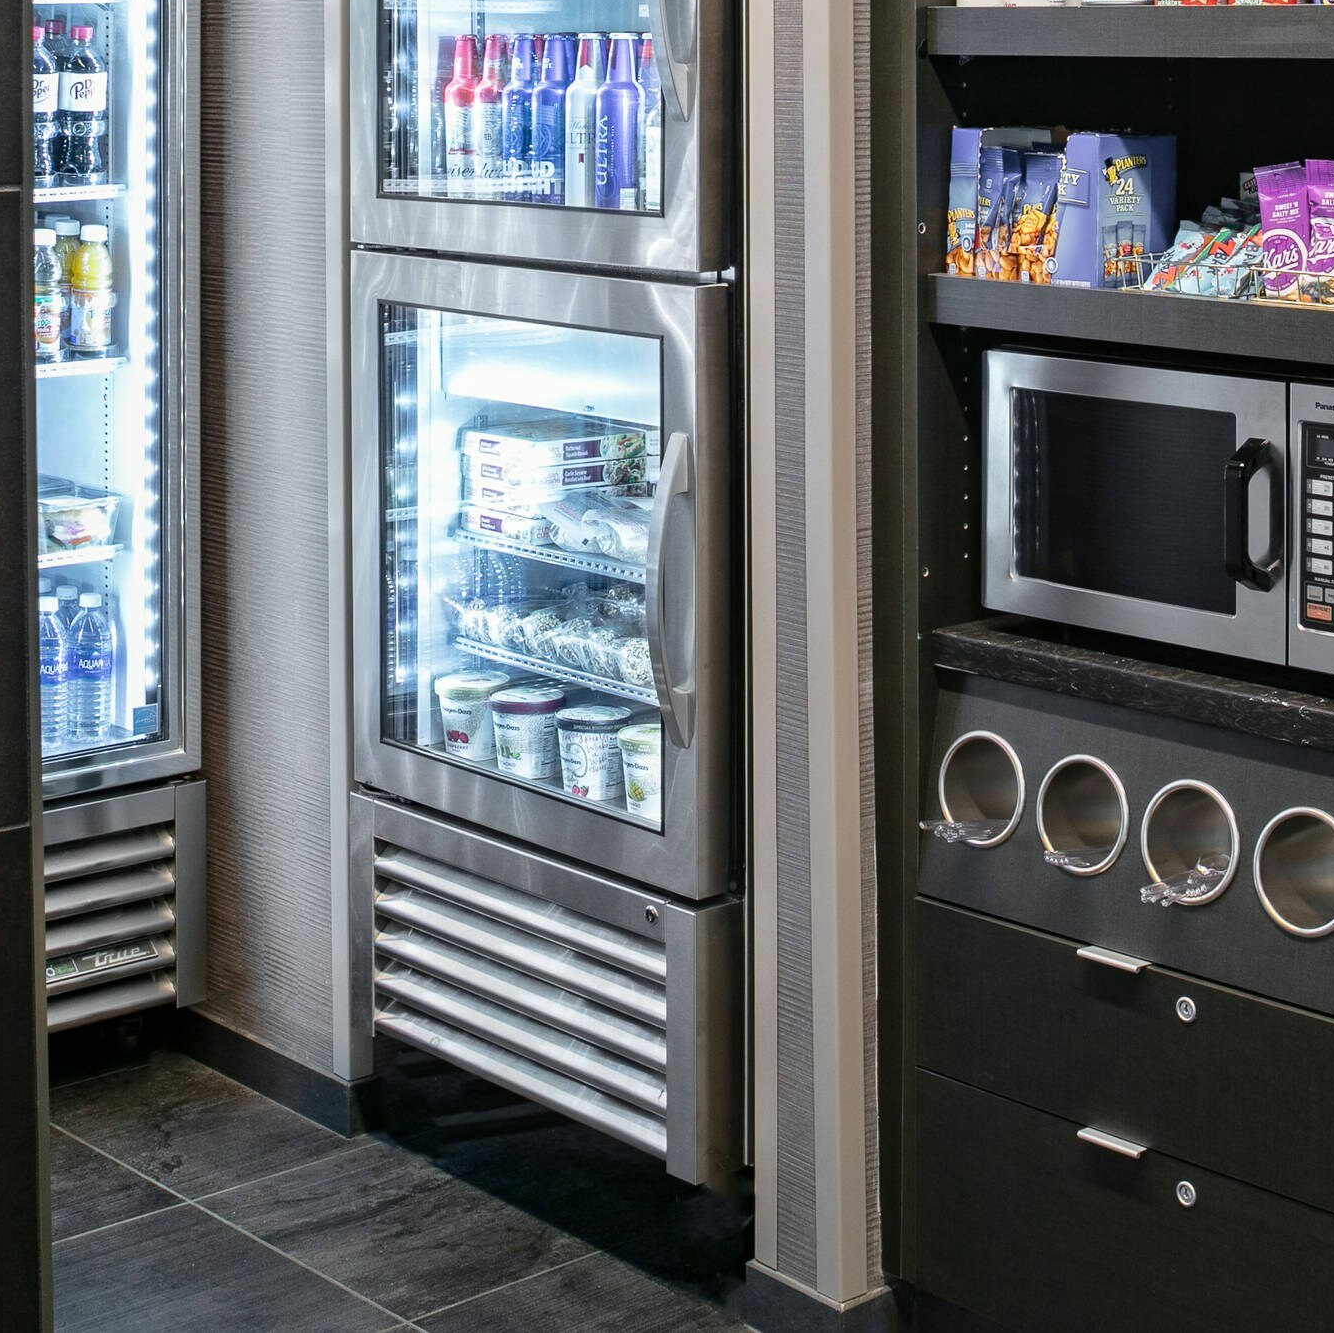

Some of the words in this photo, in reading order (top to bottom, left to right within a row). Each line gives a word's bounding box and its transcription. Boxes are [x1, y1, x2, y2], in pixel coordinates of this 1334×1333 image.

[597, 115, 608, 185] ULTRA
[1115, 156, 1147, 171] PLANTERS
[1115, 177, 1134, 195] 24
[1110, 196, 1142, 205] VARIETY
[1275, 202, 1293, 211] SWEET
[1116, 204, 1134, 213] PACK
[1272, 210, 1289, 218] SALTY
[1263, 244, 1299, 268] Kar's
